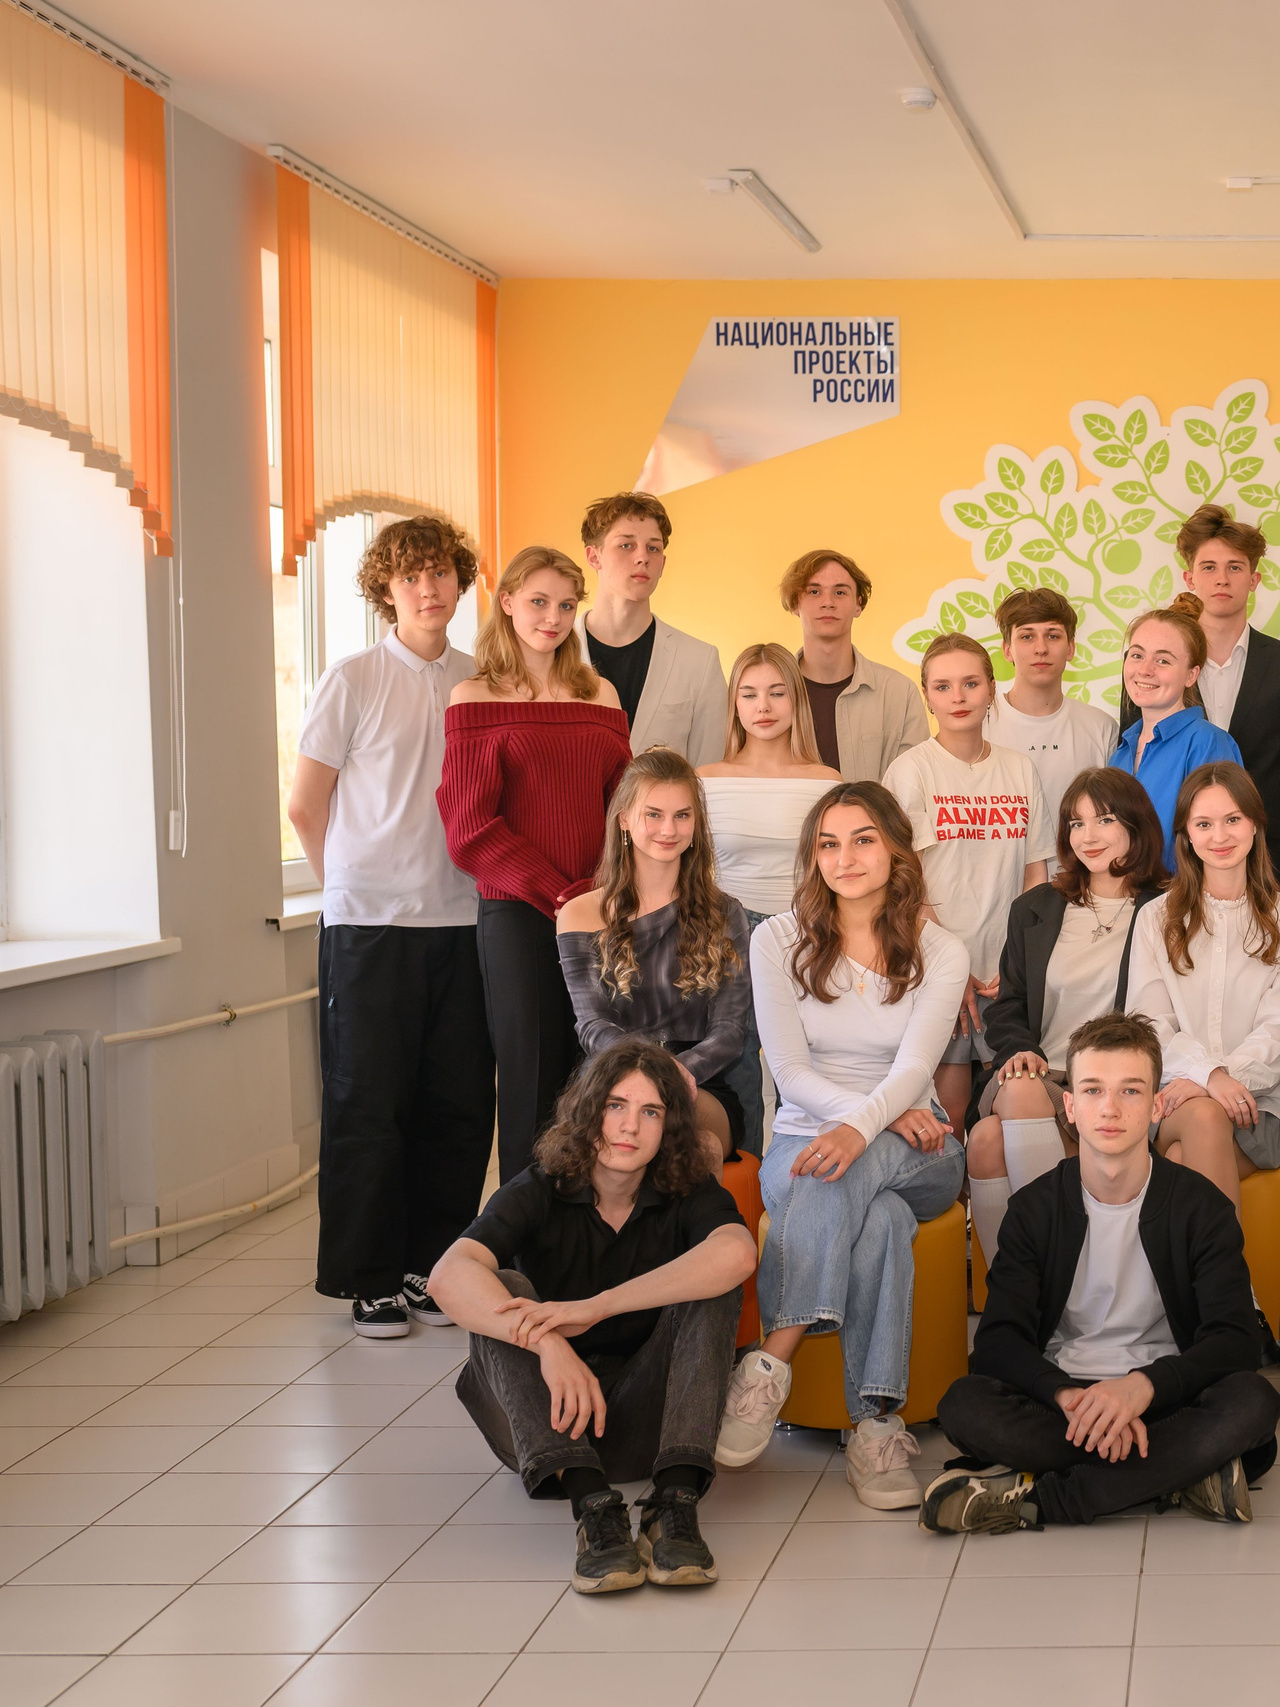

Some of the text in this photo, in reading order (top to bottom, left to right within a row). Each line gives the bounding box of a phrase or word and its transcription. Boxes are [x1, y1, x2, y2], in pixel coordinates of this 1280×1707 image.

[716, 321, 895, 349] НАЦИОНАЛЬНЫЕ
[794, 350, 895, 374] ПРОЕКТЫ
[813, 378, 895, 403] РОССИИ
[933, 794, 972, 805] WHEN
[974, 795, 988, 805] IN
[936, 806, 1029, 827] ALWAYS
[936, 827, 1028, 841] BLAME A MA
